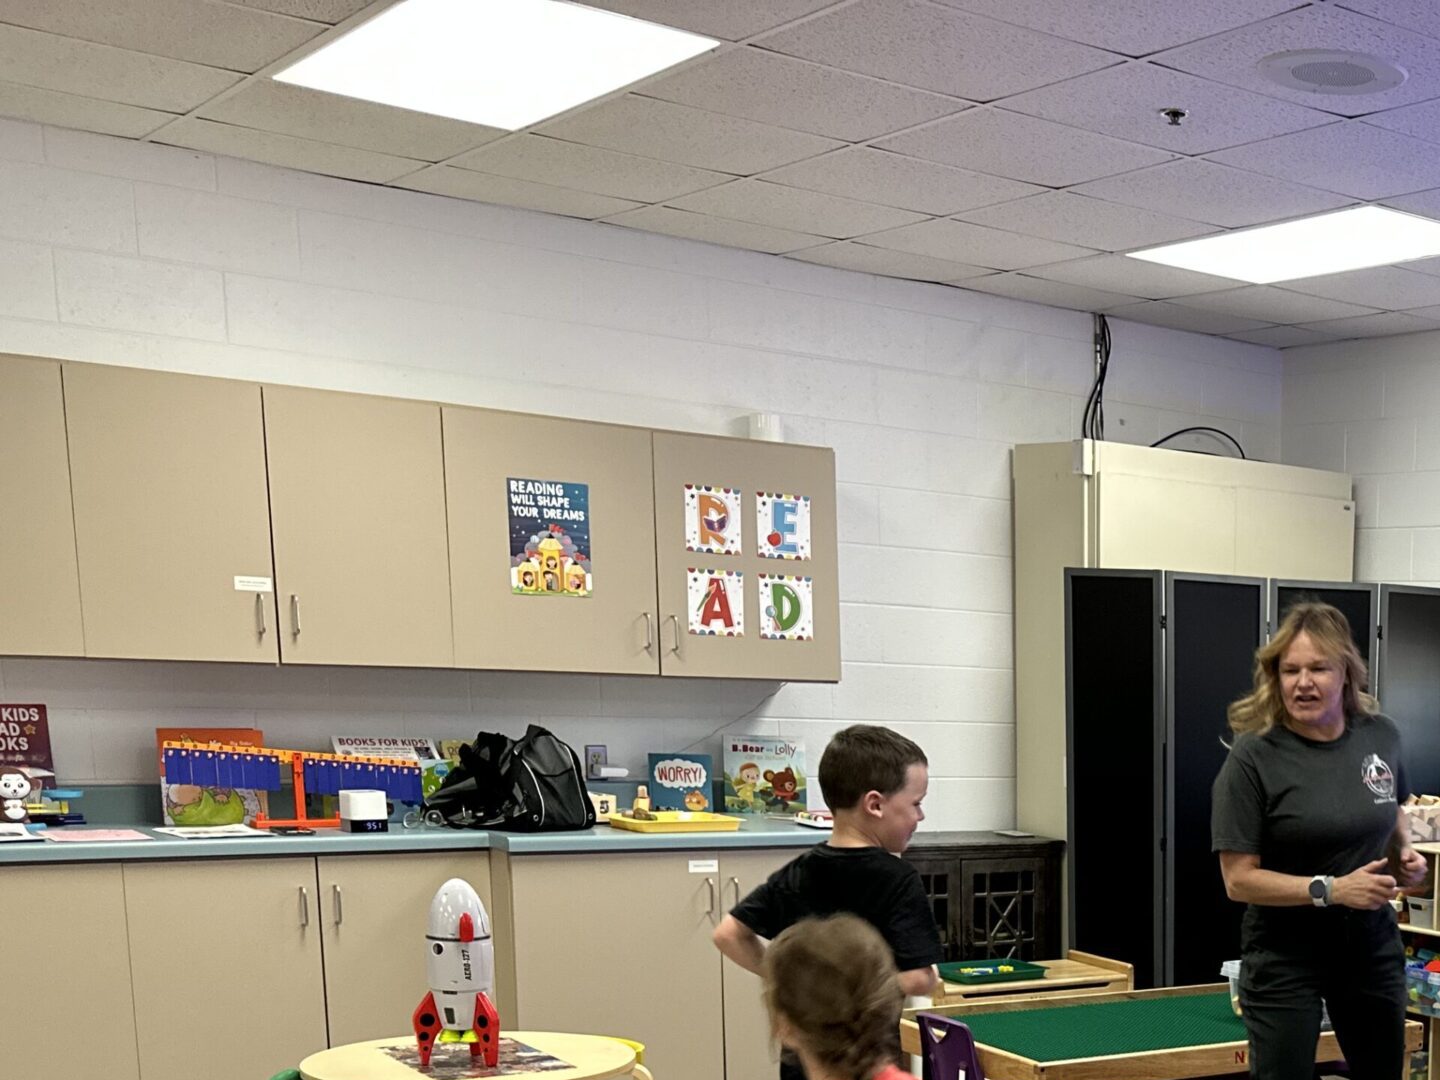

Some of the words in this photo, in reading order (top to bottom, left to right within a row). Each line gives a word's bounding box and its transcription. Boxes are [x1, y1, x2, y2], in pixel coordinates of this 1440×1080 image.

[510, 480, 564, 496] READING
[511, 493, 535, 505] WILL
[537, 496, 570, 508] SHAPE
[512, 505, 539, 518] YOUR
[543, 508, 585, 521] DREAMS
[1, 707, 40, 722] KIDS
[338, 737, 377, 746] BOOKS
[378, 738, 399, 747] FOR
[401, 738, 429, 748] KIDS!
[774, 743, 797, 759] Lolly
[657, 766, 702, 784] WORRY!
